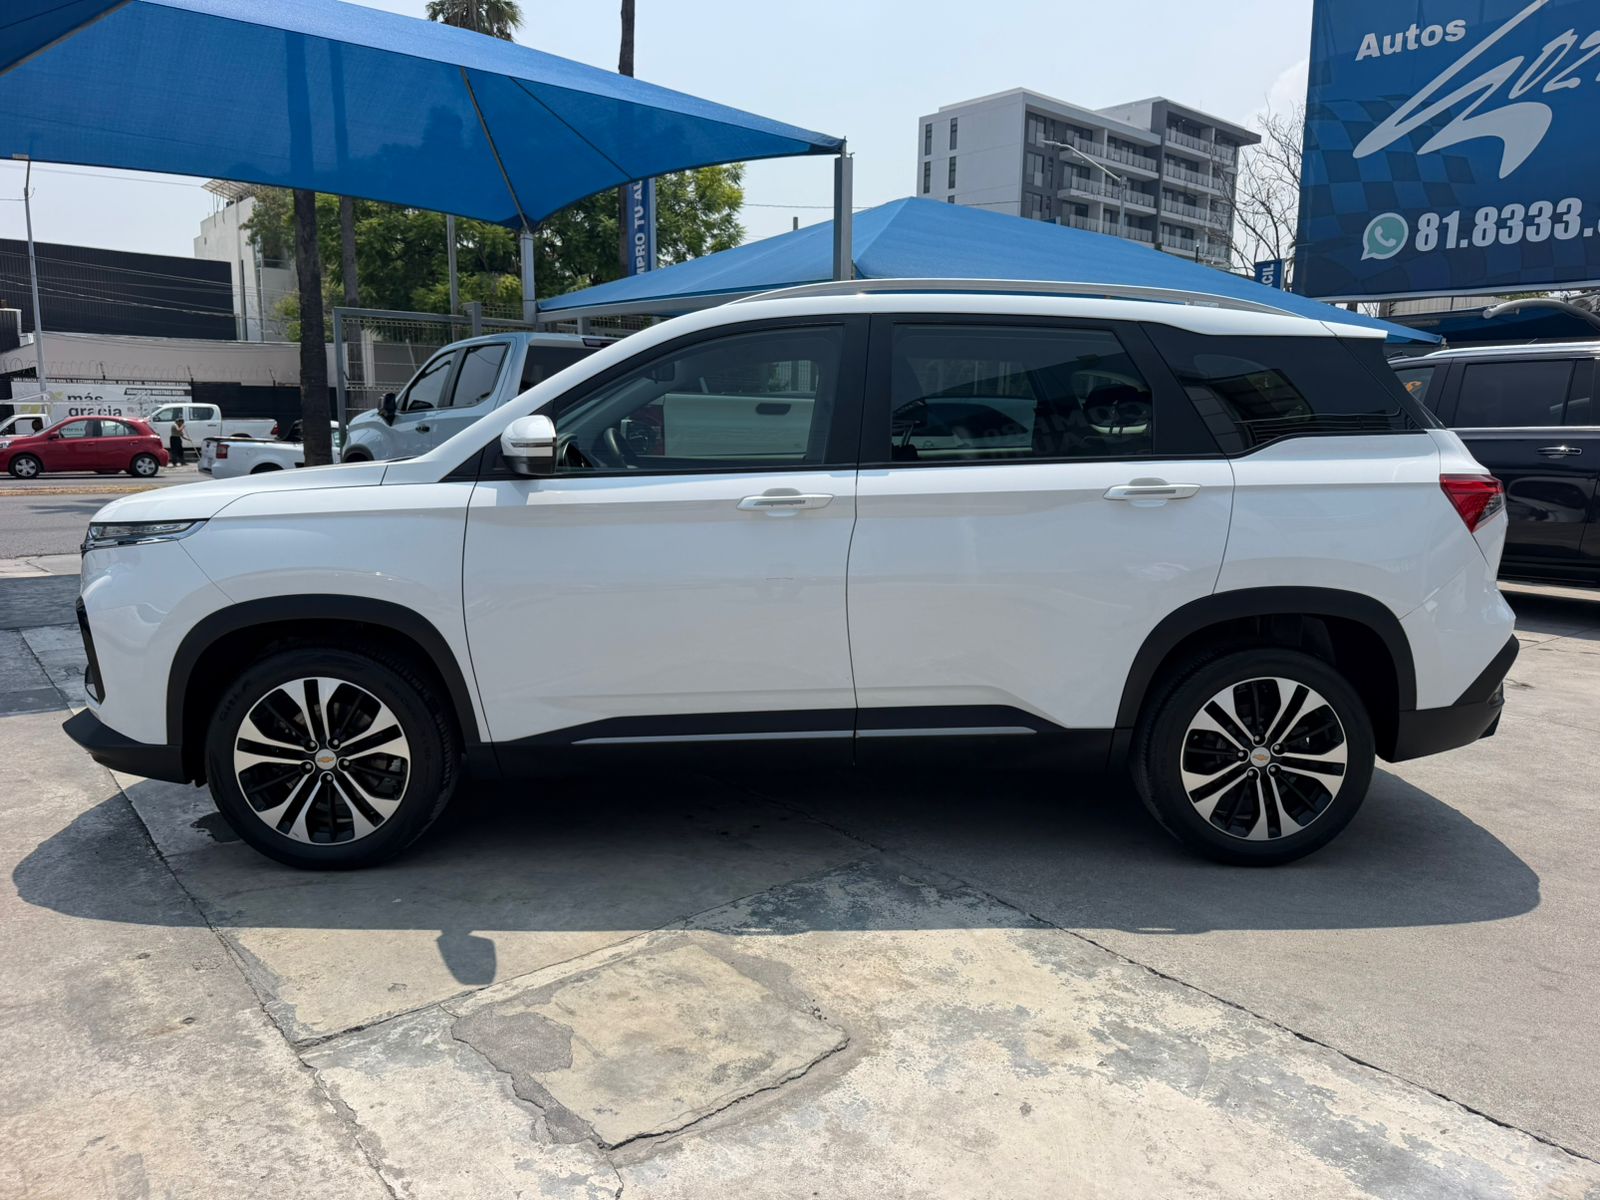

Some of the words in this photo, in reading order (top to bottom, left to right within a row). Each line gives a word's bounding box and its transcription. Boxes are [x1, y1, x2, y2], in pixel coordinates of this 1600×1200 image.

[1355, 19, 1466, 61] Autos
[634, 206, 644, 229] TU
[1414, 197, 1600, 252] 81.8333.
[1262, 263, 1275, 287] CIL
